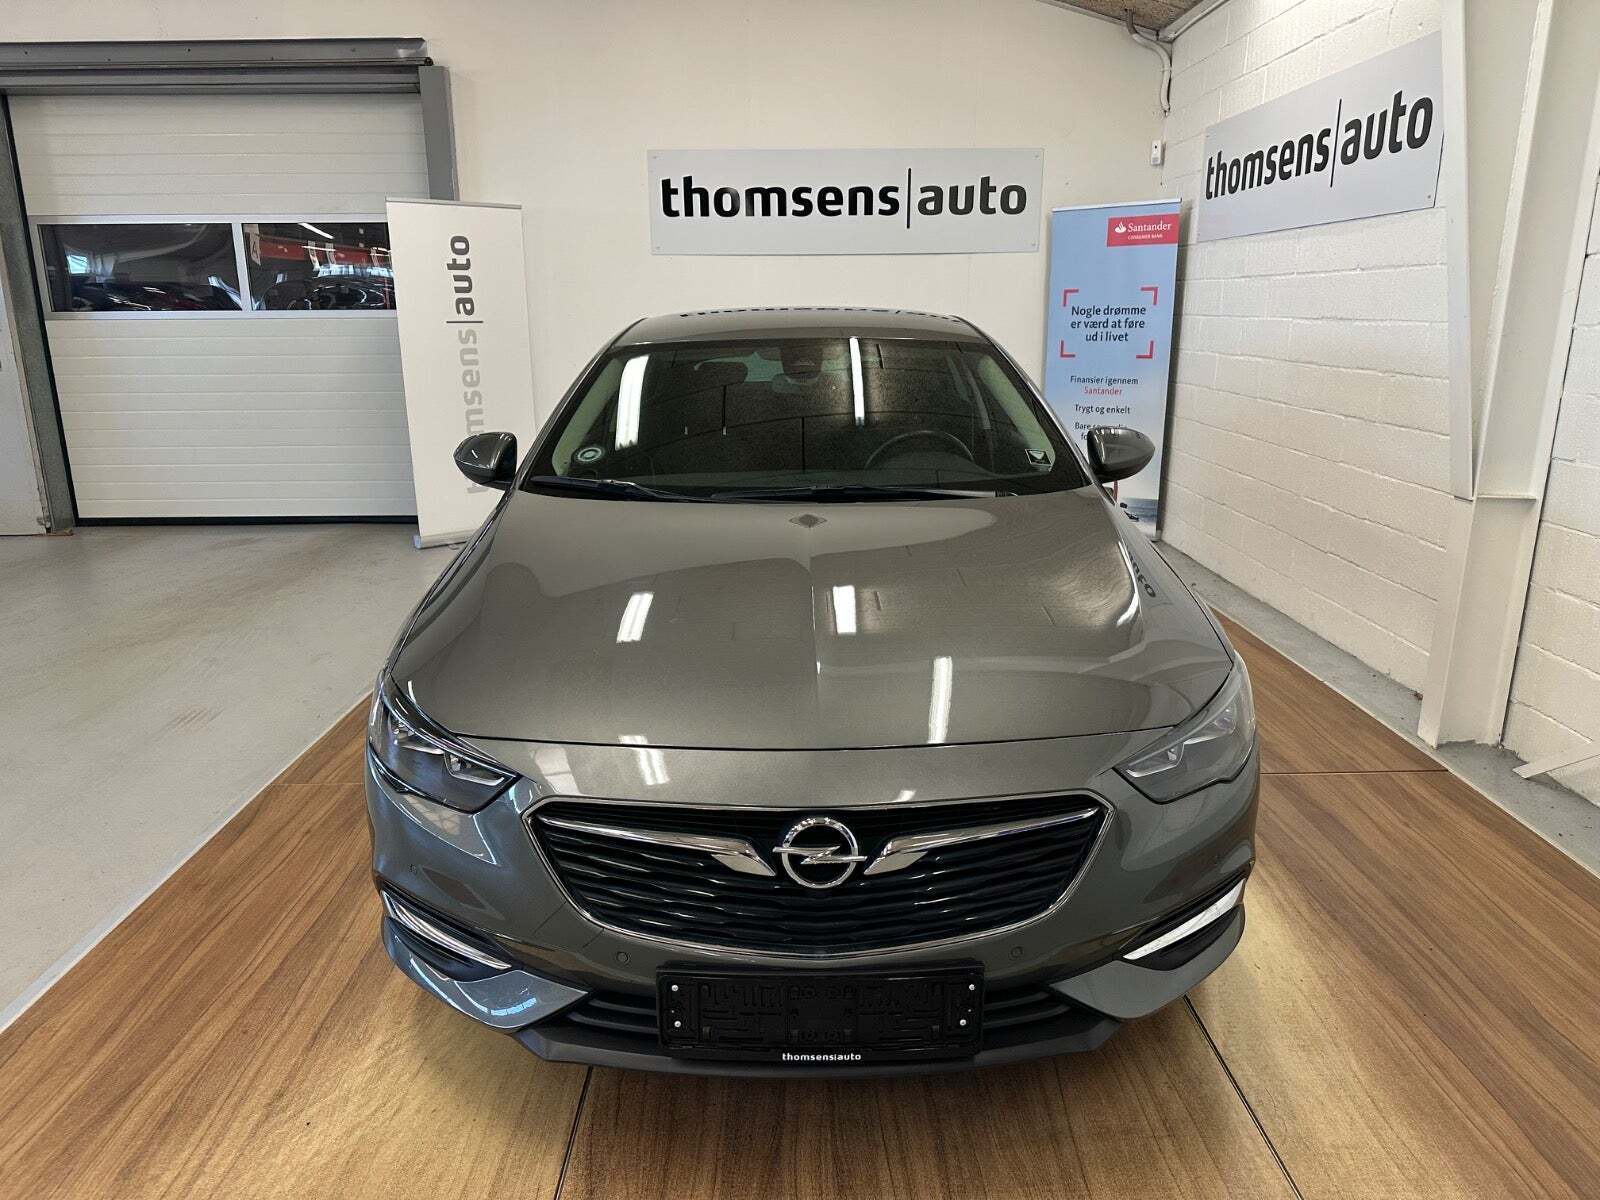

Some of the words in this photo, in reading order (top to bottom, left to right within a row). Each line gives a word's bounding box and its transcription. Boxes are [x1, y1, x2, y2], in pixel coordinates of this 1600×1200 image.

[1127, 219, 1172, 233] Santander
[1071, 305, 1102, 318] Nogle
[1103, 304, 1147, 315] drømme
[1070, 320, 1081, 328] er
[1083, 318, 1109, 328] værd
[1111, 319, 1121, 328] at
[1124, 317, 1145, 328] føre
[1085, 331, 1098, 341] ud
[1100, 331, 1104, 341] i
[1106, 331, 1129, 341] livet
[1070, 375, 1103, 384] Finansier
[1105, 376, 1139, 386] igennem
[1084, 386, 1122, 395] Santander
[1075, 404, 1094, 414] Trygt
[1095, 406, 1105, 415] og
[1106, 405, 1131, 414] enkelt
[1074, 422, 1091, 430] Bare
